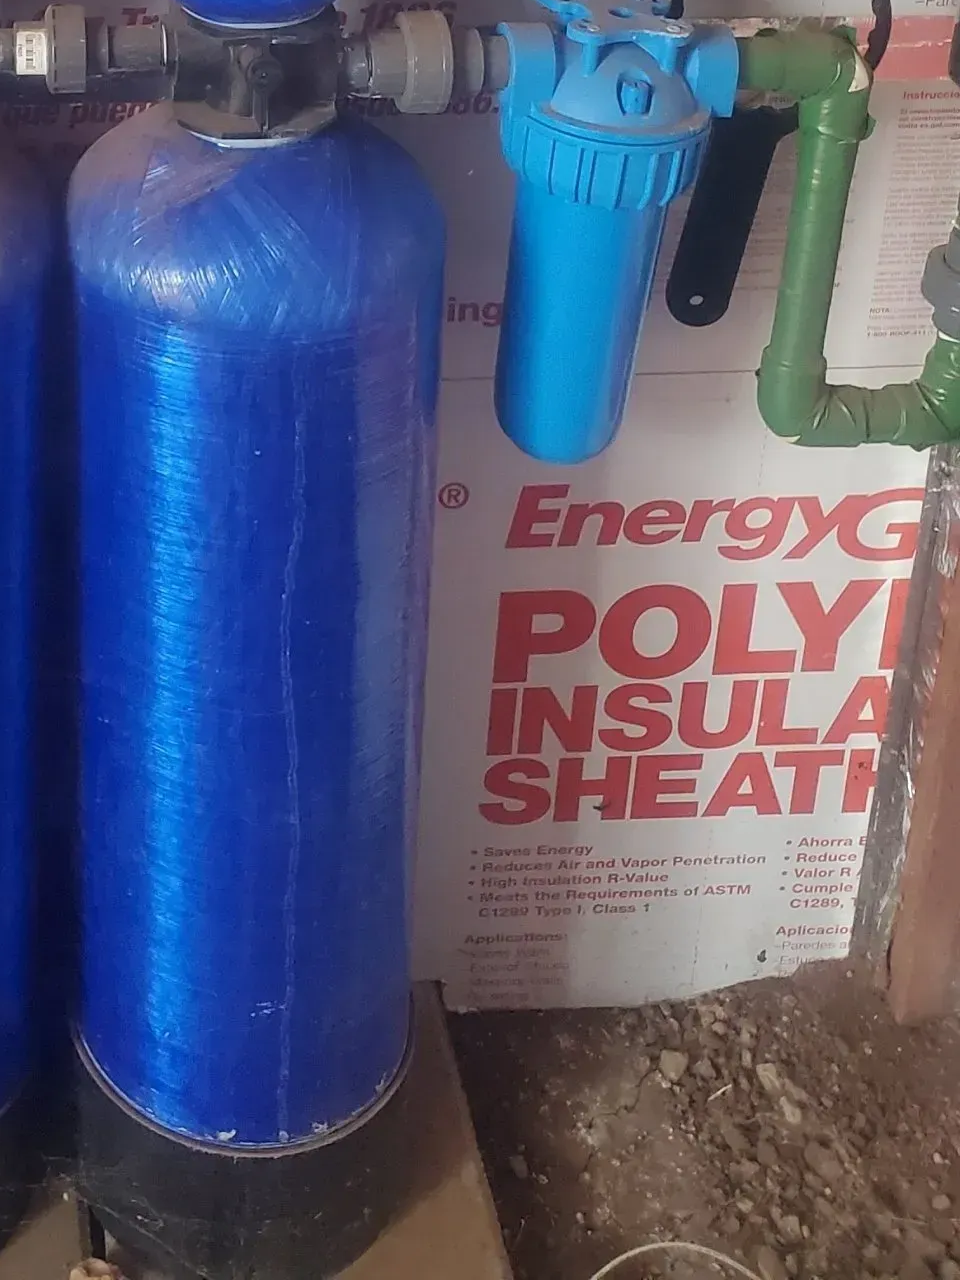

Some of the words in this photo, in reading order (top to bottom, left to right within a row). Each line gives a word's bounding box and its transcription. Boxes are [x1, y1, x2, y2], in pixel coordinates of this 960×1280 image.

[797, 836, 853, 847] Ahorra
[484, 846, 531, 857] Saves
[536, 844, 593, 857] Energy
[482, 861, 553, 872] Reduces
[557, 859, 579, 870] Air
[586, 858, 616, 869] and
[620, 857, 667, 870] Vapor
[672, 854, 766, 866] Penetration
[796, 852, 857, 863] Reduce
[794, 867, 836, 878] Valor
[840, 867, 851, 877] R
[481, 877, 517, 889] High
[522, 874, 601, 886] Insulation
[607, 872, 669, 884] R-Value
[479, 891, 529, 902] Meets
[535, 890, 560, 901] the
[566, 887, 678, 901] Requirements
[683, 885, 699, 896] of
[703, 884, 751, 896] ASTM
[792, 882, 853, 894] Cumple
[535, 906, 571, 918] Type
[592, 903, 636, 915] Class
[643, 902, 650, 913] 1
[789, 898, 844, 910] C1289,
[464, 932, 568, 945] Applications:
